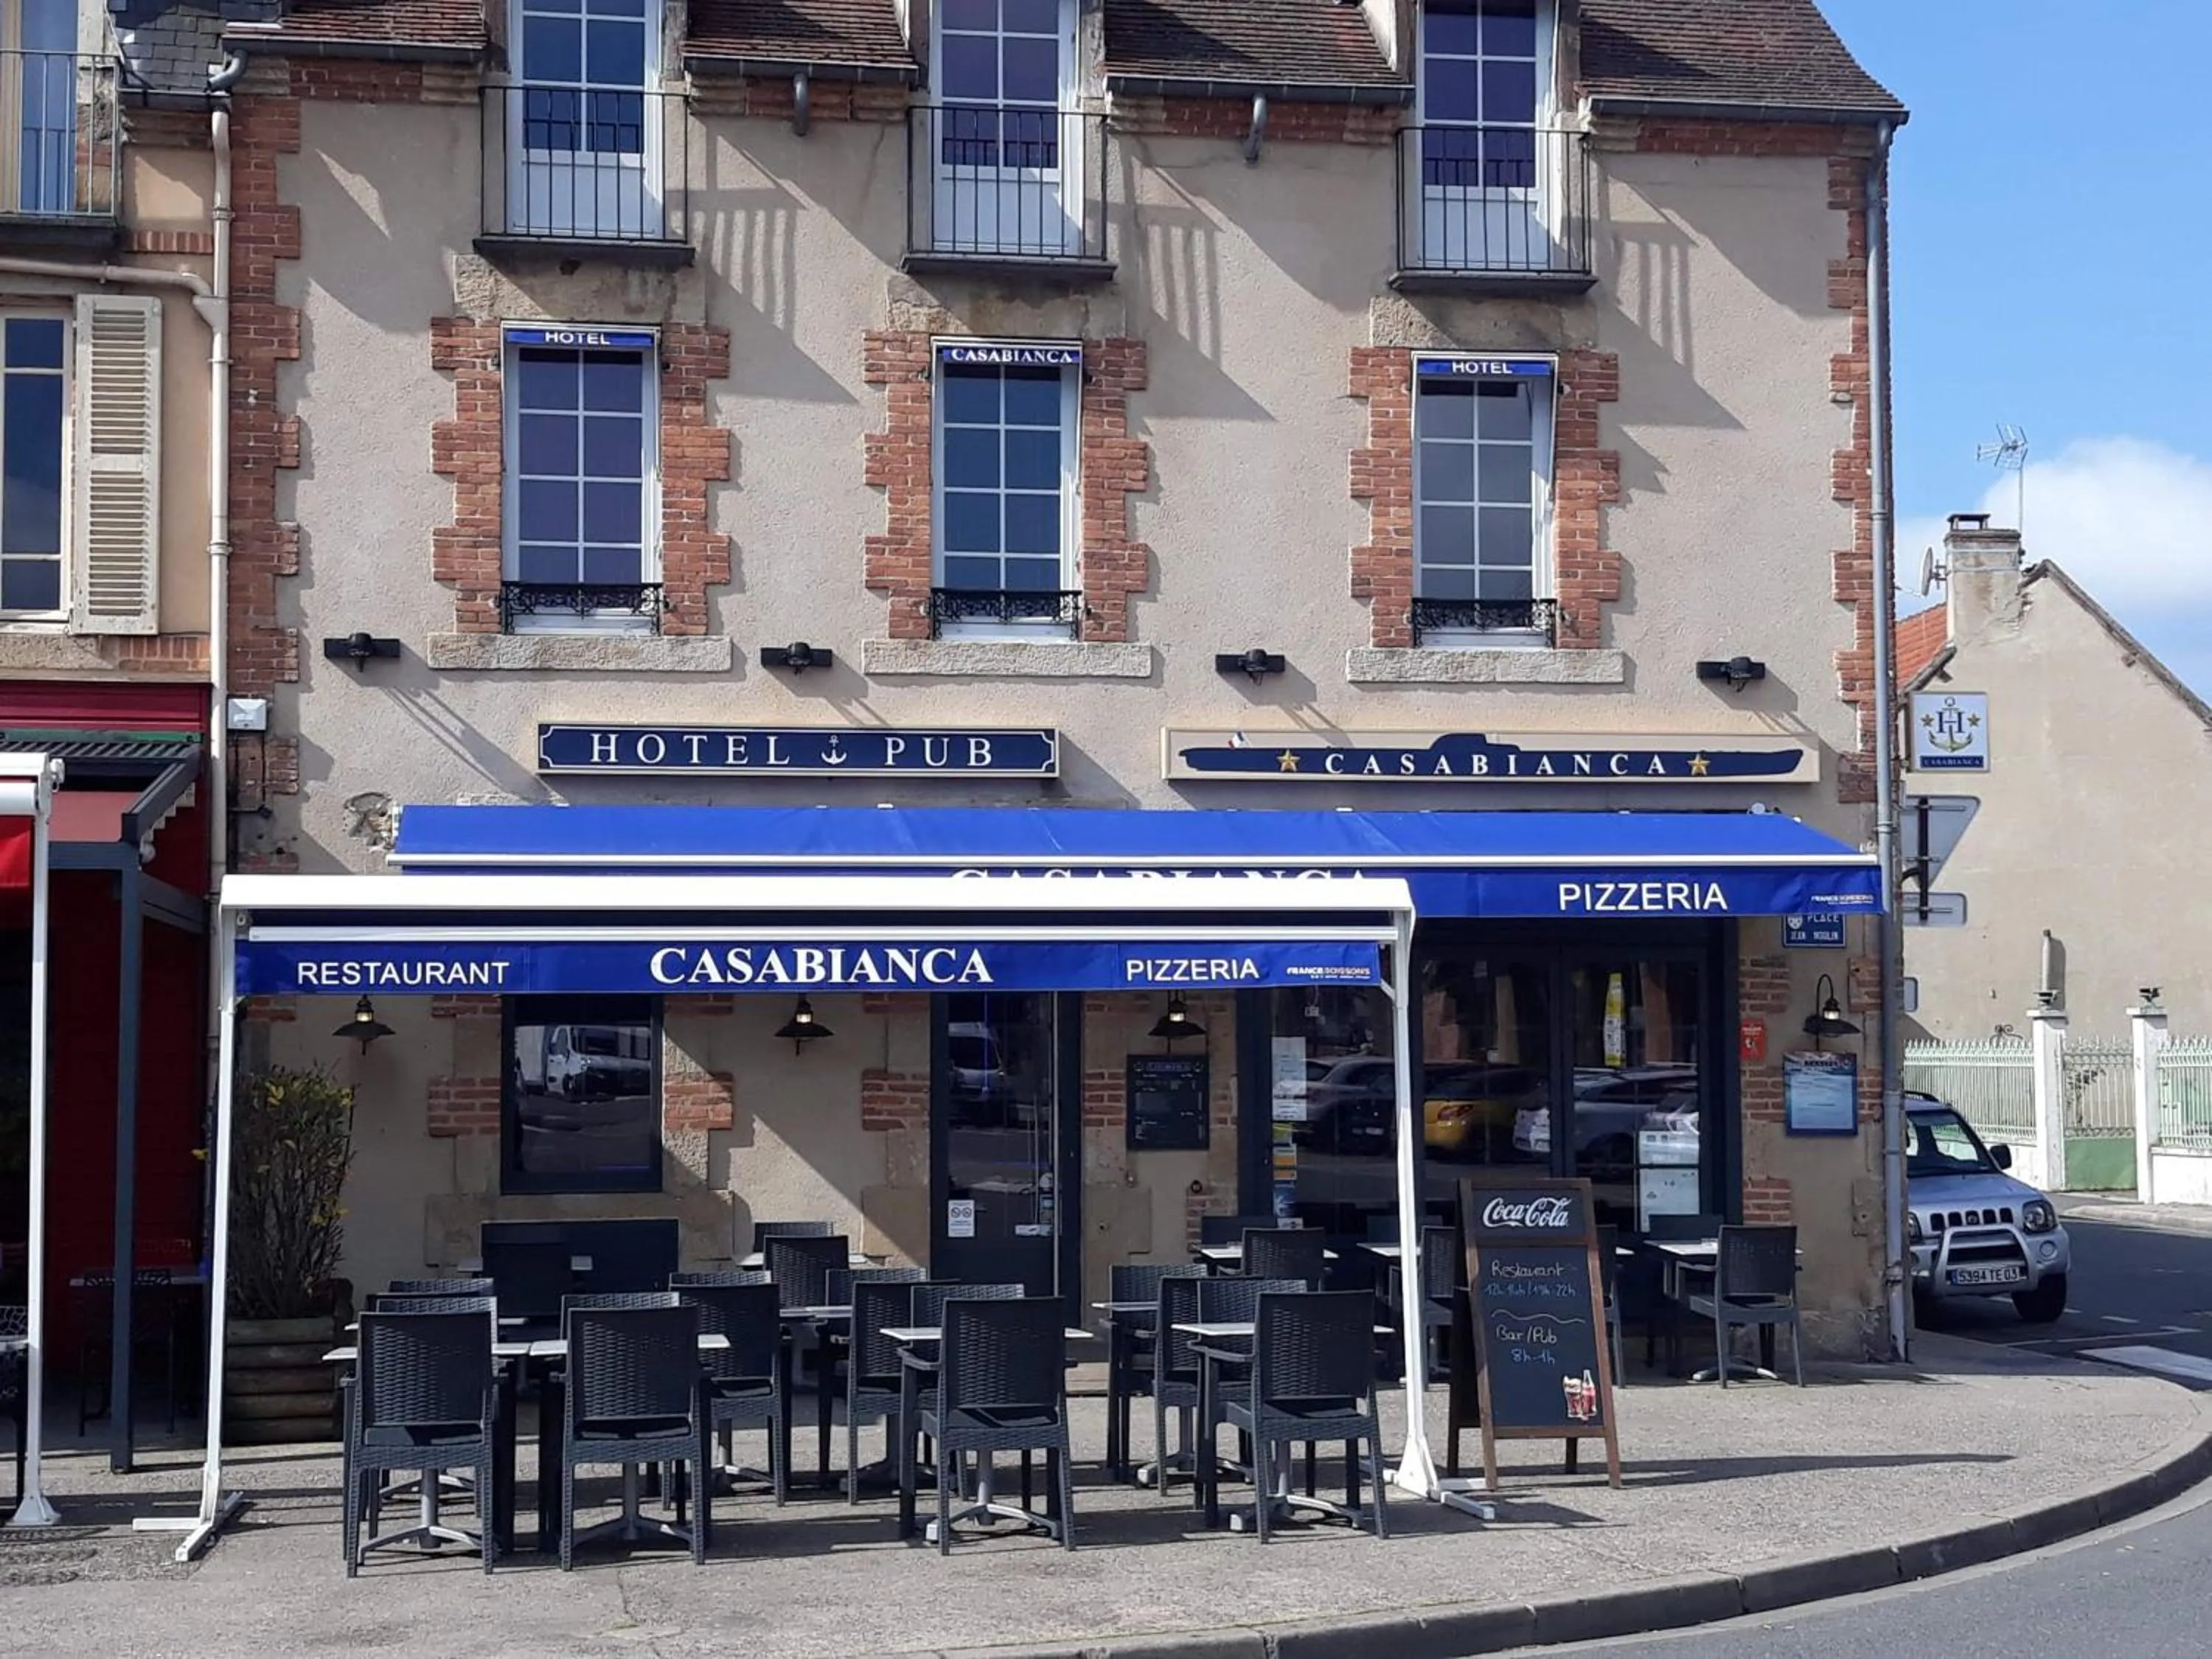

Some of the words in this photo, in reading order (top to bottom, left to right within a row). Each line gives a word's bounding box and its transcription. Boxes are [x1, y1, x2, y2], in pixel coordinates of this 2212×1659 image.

[544, 332, 611, 345] HOTEL
[951, 349, 1073, 363] CASABIANCA
[1452, 361, 1513, 374] HOTEL
[590, 734, 790, 766] HOTEL
[885, 737, 993, 767] PUB
[1325, 754, 1666, 776] CASABIANCA
[1559, 883, 1728, 911] PIZZERIA
[297, 961, 510, 985] RESTAURANT
[650, 947, 994, 984] CASABIANCA
[1126, 959, 1260, 981] PIZZERIA
[1483, 1197, 1572, 1228] Coca-Cola
